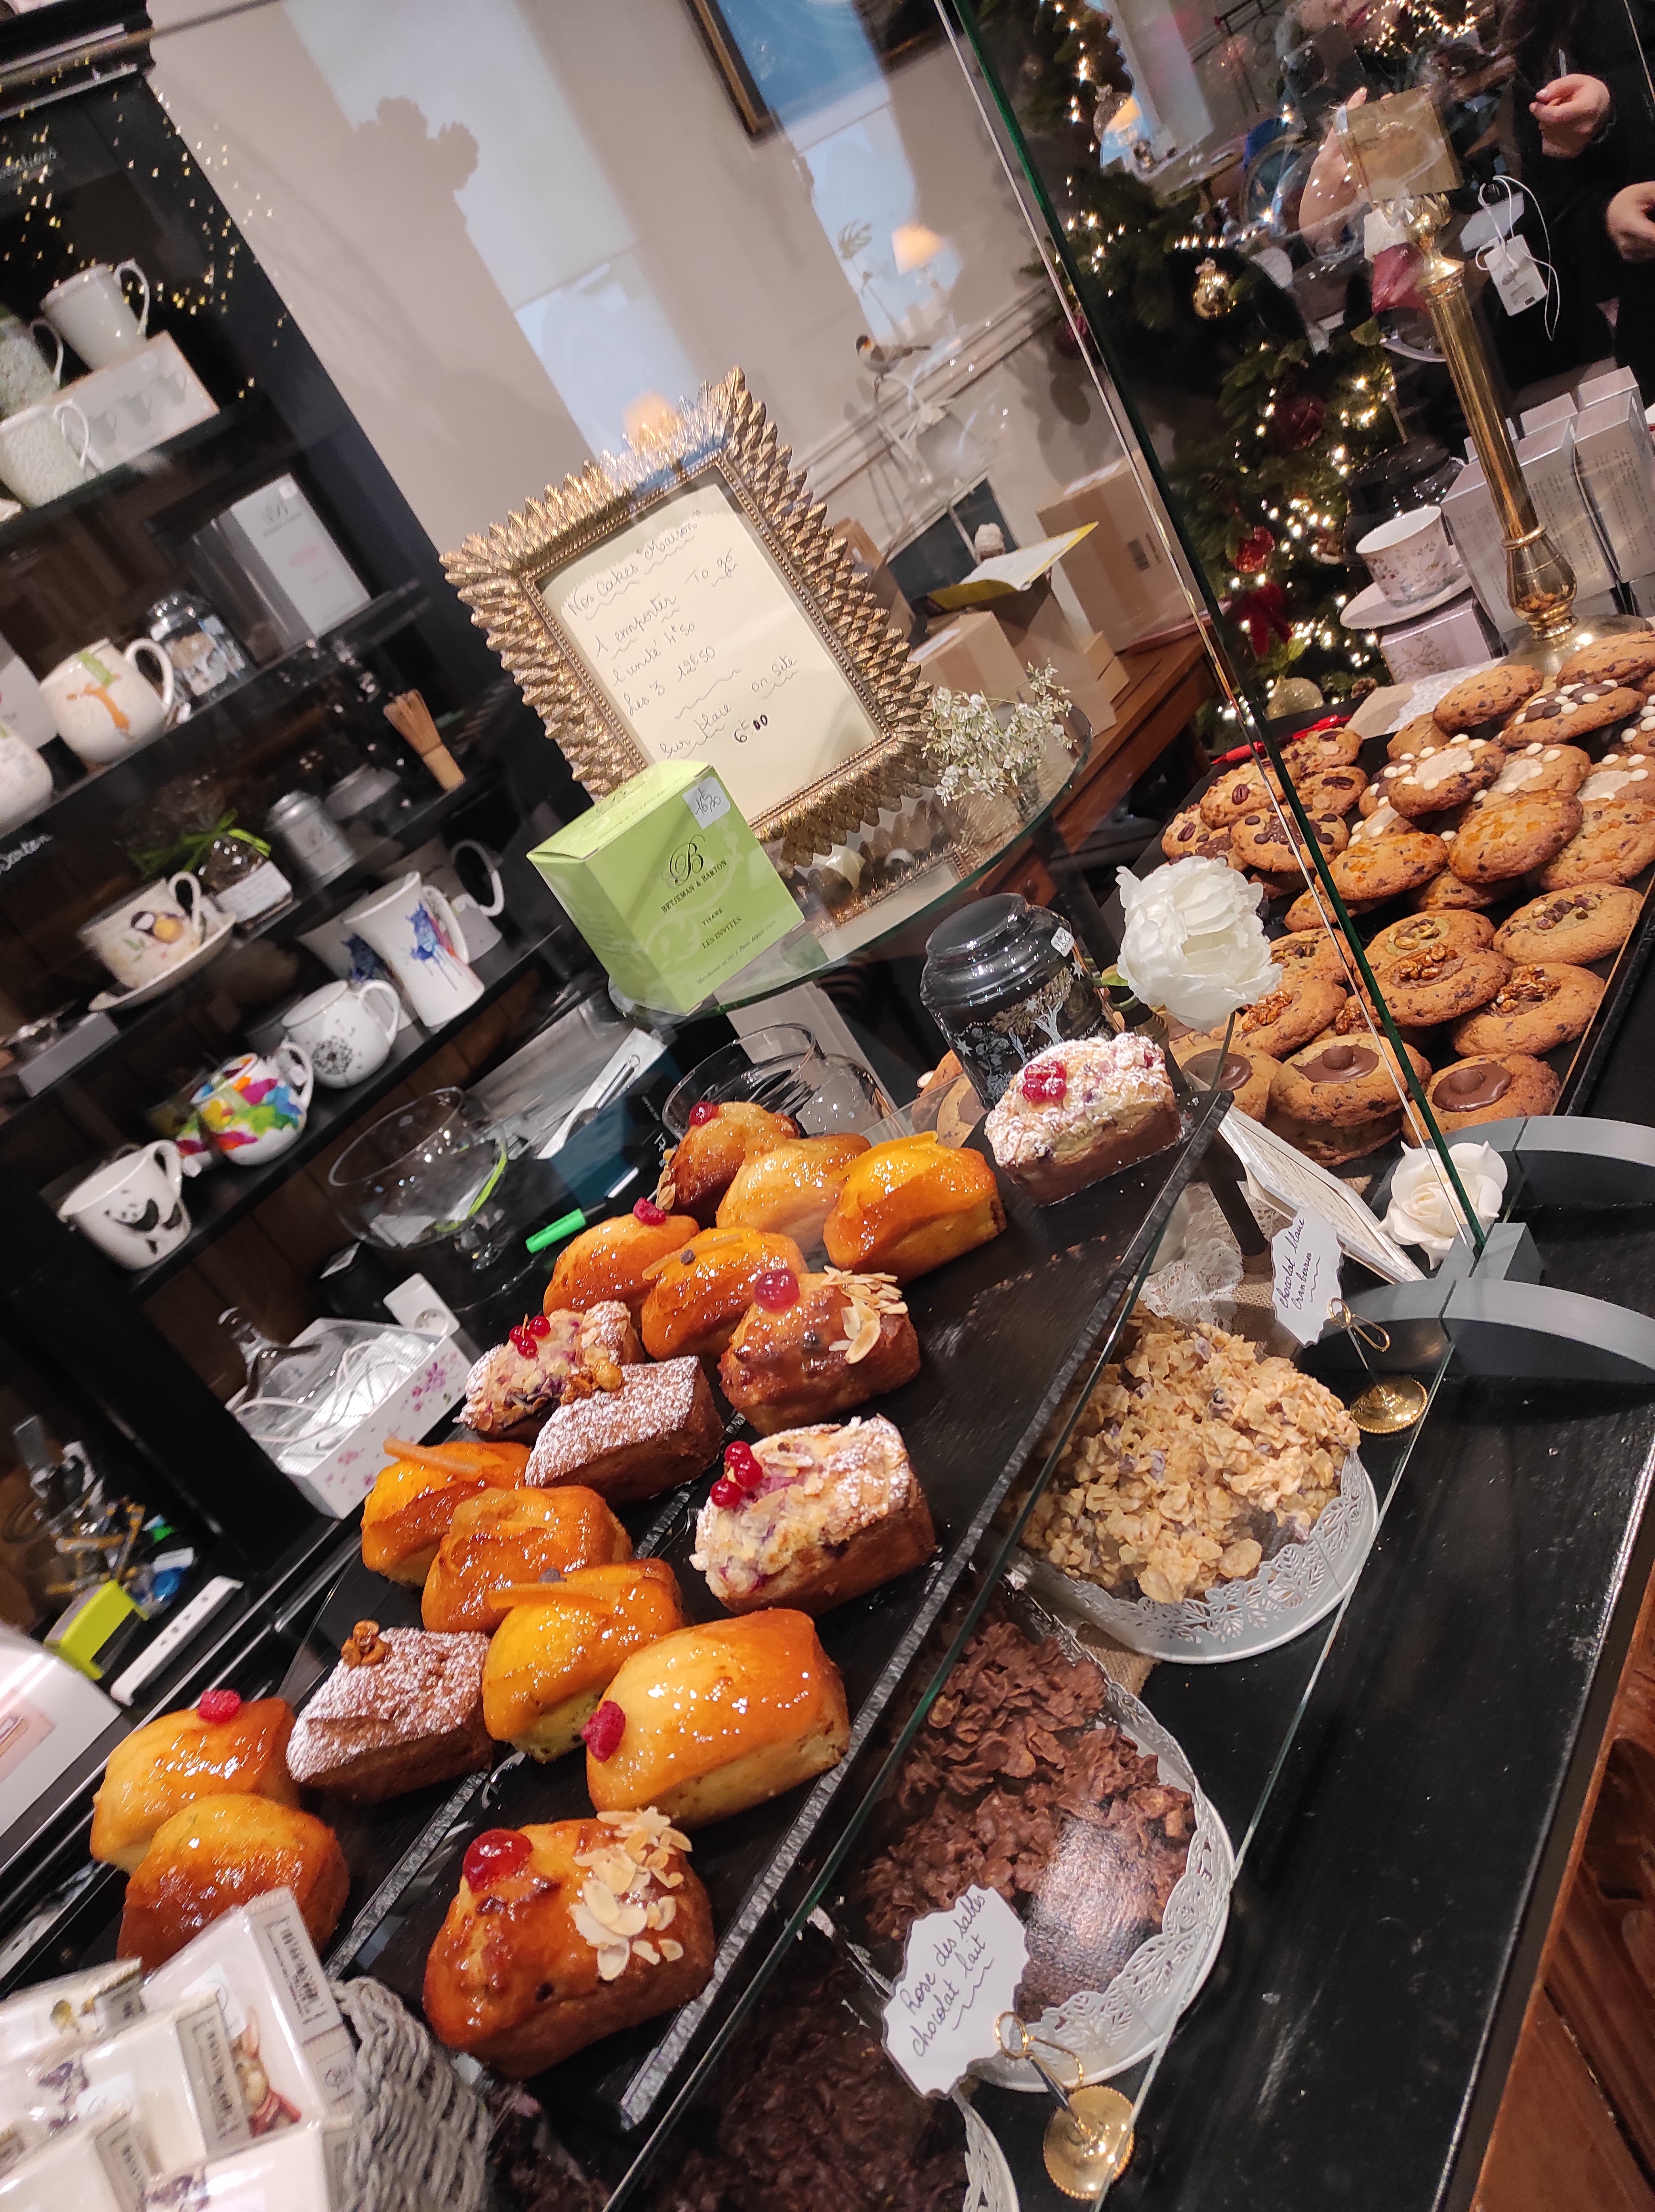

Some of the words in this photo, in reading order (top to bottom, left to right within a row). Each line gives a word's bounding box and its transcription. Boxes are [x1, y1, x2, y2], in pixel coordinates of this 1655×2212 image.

[596, 564, 638, 596] Cakes
[615, 592, 676, 643] emporter
[648, 680, 665, 696] 3
[661, 885, 695, 913] BETJEMAN
[701, 860, 727, 882] BARTON
[702, 908, 723, 926] TISANE
[702, 937, 715, 949] LES
[899, 1972, 936, 2015] Rose
[933, 1938, 957, 1967] des
[953, 1894, 986, 1939] sables
[955, 1934, 986, 1978] lait
